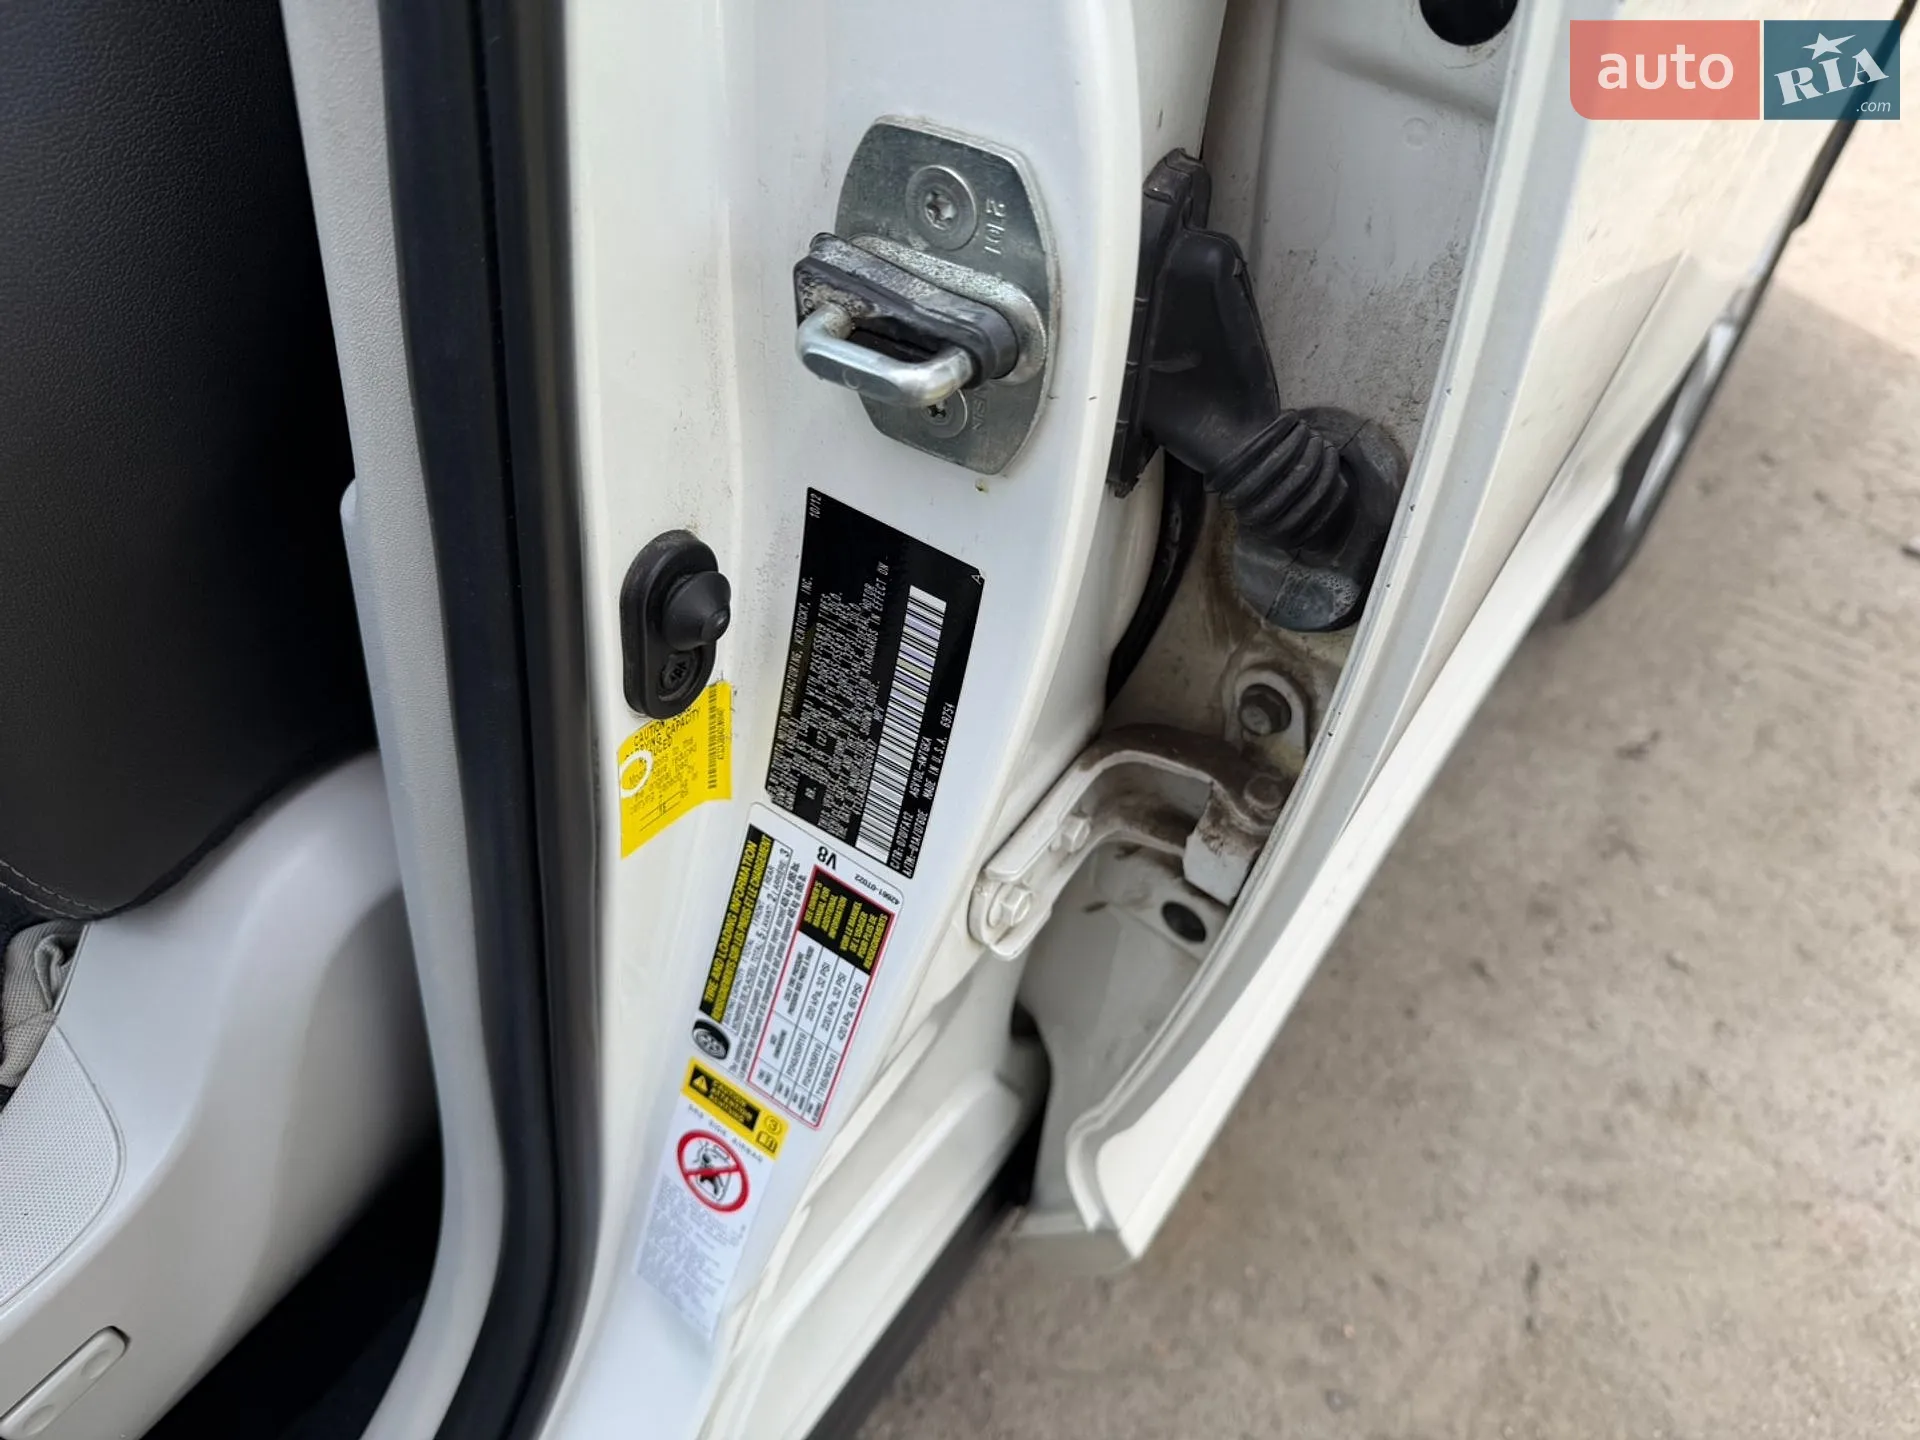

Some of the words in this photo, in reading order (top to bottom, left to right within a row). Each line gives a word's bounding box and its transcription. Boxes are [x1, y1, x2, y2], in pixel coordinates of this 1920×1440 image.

[809, 492, 821, 519] 10/12
[800, 572, 812, 596] INC.
[871, 576, 886, 612] EFFECT
[793, 597, 809, 646] KENTUCKY,
[869, 612, 881, 625] IN
[860, 626, 878, 675] STANDARDS
[776, 714, 789, 742] MOTOR
[931, 732, 947, 764] U.S.A.
[927, 763, 939, 777] IN
[921, 777, 936, 800] MADE
[749, 833, 772, 887] CHARGEMENT
[779, 847, 790, 858] 3
[816, 844, 840, 870] V8
[729, 838, 758, 913] INFORMATION
[743, 892, 755, 908] ET
[746, 882, 758, 897] LE
[766, 892, 776, 903] 2
[716, 911, 737, 959] LOADING
[755, 930, 765, 940] 5
[710, 956, 725, 982] AND
[818, 960, 832, 978] PSI
[834, 970, 848, 988] PSI
[704, 978, 718, 1003] TIRE
[851, 981, 864, 999] PSI
